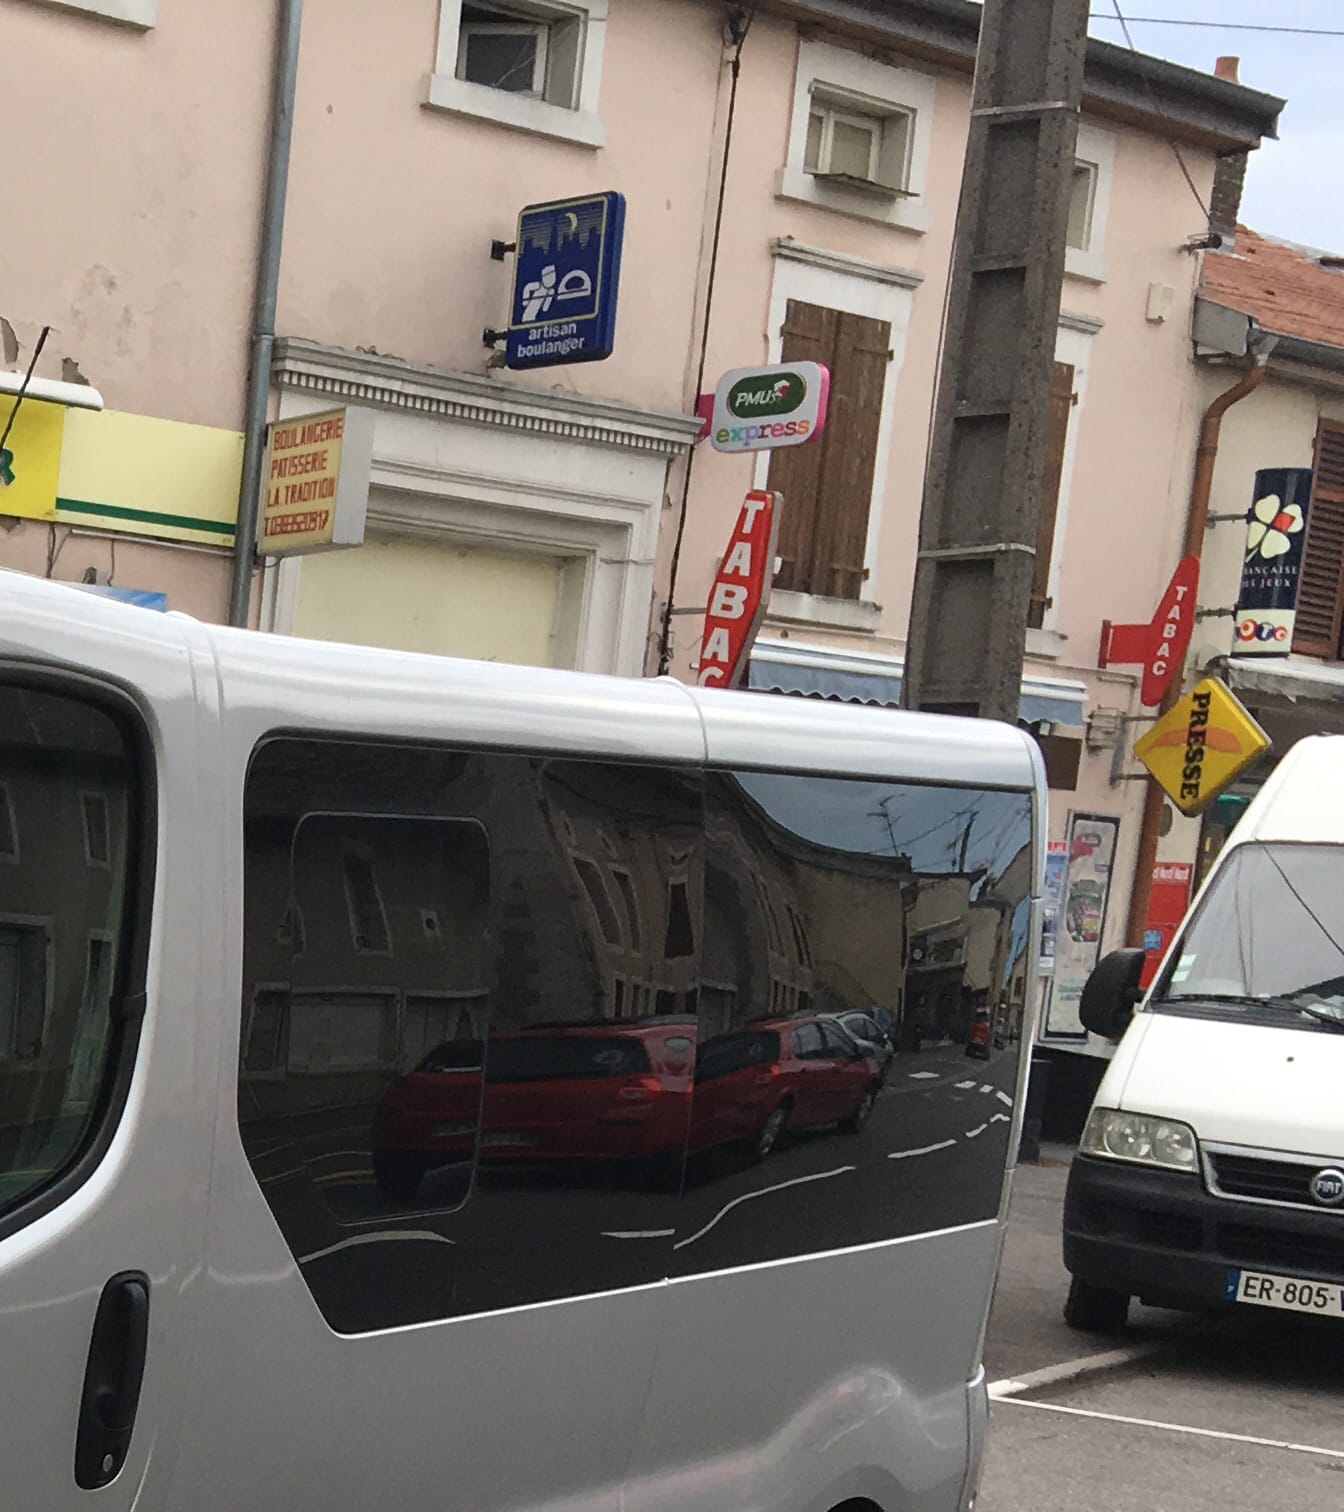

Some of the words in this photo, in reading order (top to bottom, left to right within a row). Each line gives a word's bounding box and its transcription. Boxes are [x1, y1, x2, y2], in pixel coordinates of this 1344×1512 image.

[528, 323, 577, 340] artisan
[517, 337, 585, 358] boulanger
[735, 389, 772, 408] PMU
[273, 417, 343, 451] BOULANGERIE
[716, 420, 810, 446] express
[271, 449, 328, 480] PATISSERIE
[267, 486, 280, 508] LA
[285, 476, 336, 505] TRADITION
[1152, 585, 1188, 676] TABAC
[1180, 691, 1212, 800] PRESSE
[1316, 1180, 1342, 1195] FIAT
[1243, 1275, 1344, 1312] ER-805-
